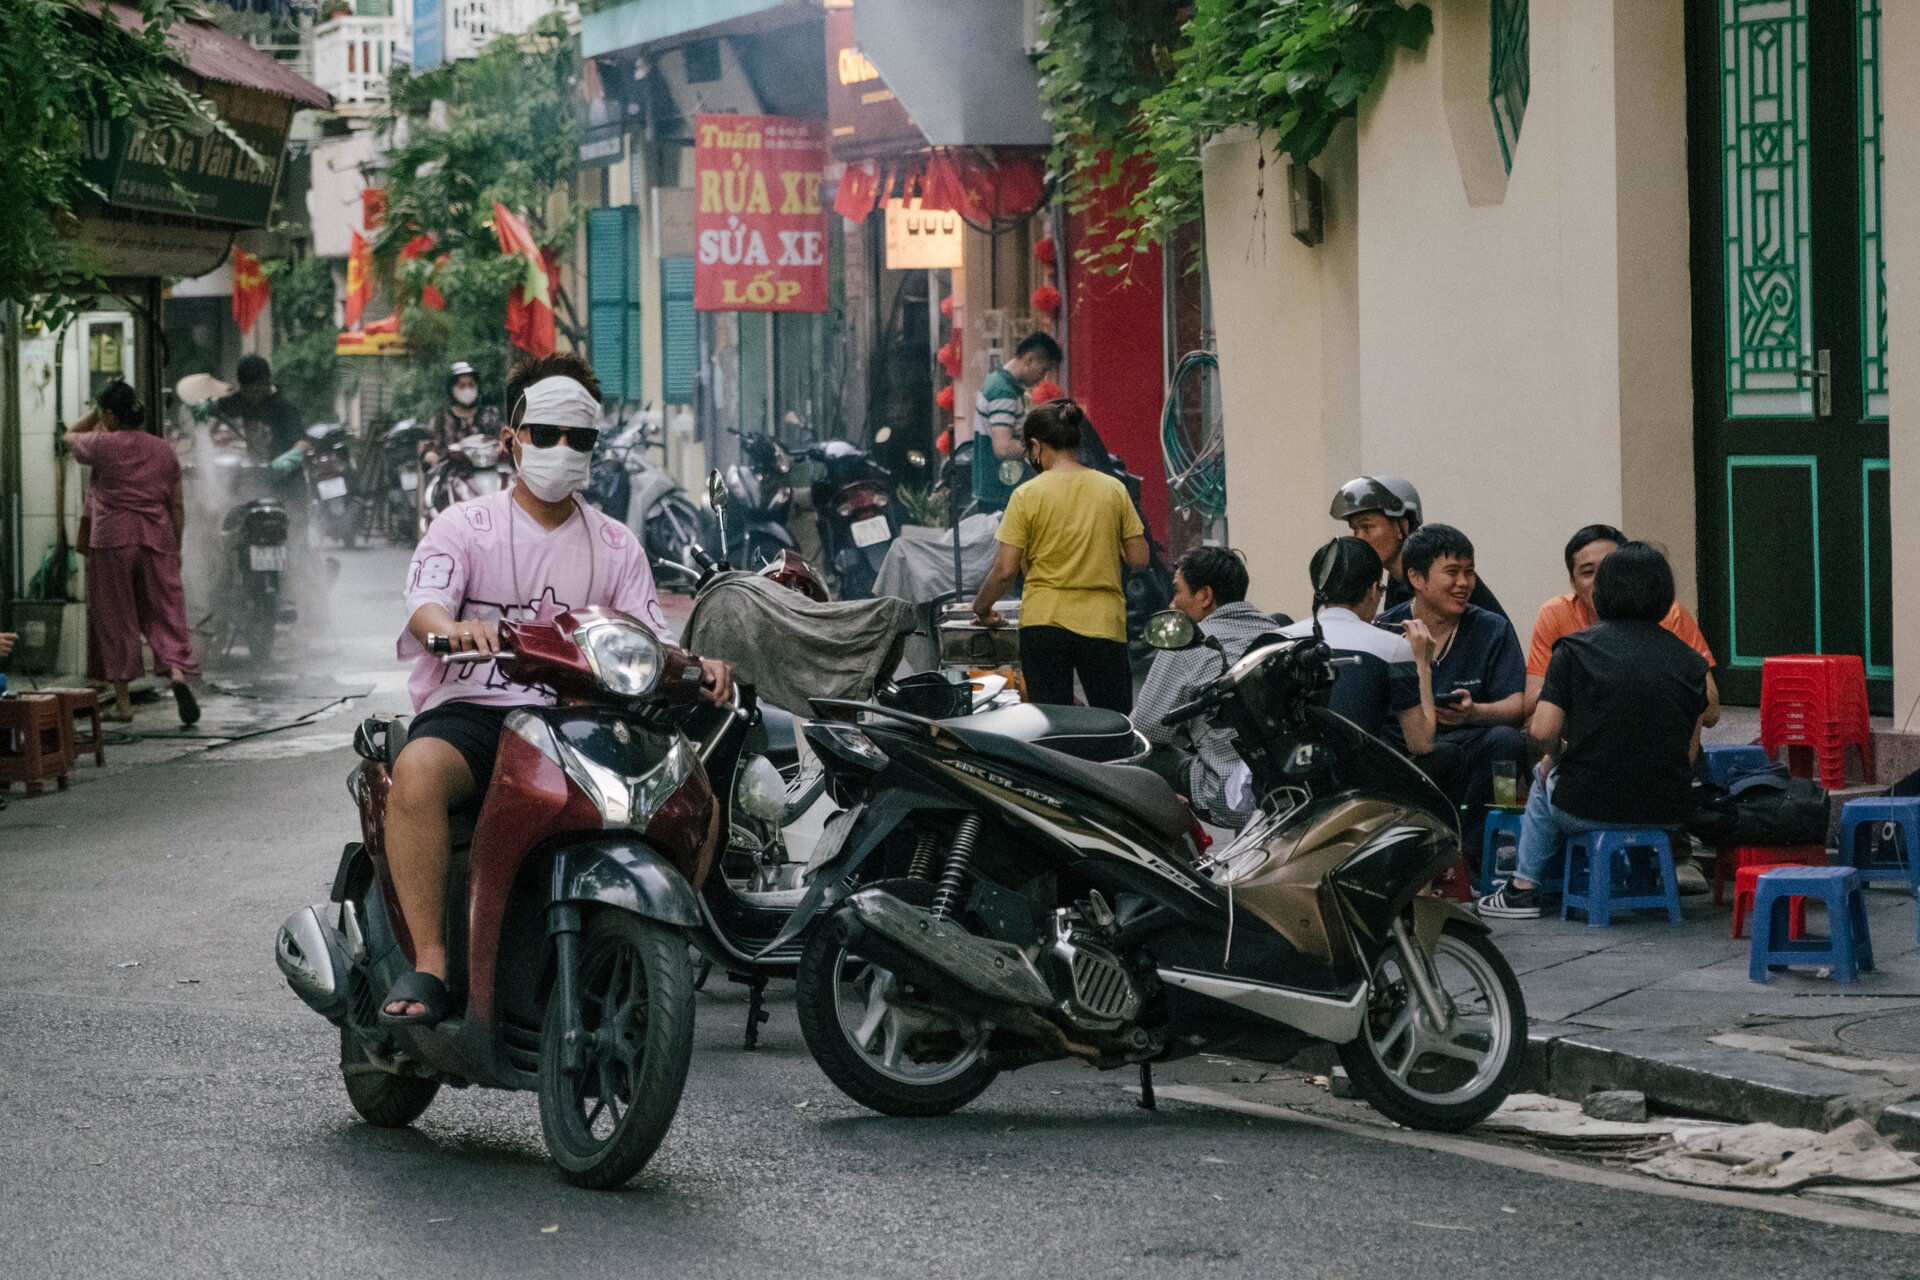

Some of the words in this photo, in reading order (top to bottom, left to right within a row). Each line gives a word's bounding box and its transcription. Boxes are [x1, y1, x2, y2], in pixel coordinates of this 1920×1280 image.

[701, 122, 762, 148] Tuấn
[700, 151, 771, 213] RỬA
[781, 172, 823, 214] XE
[700, 215, 769, 265] SỬA
[778, 231, 824, 266] XE
[723, 270, 800, 304] LỐP
